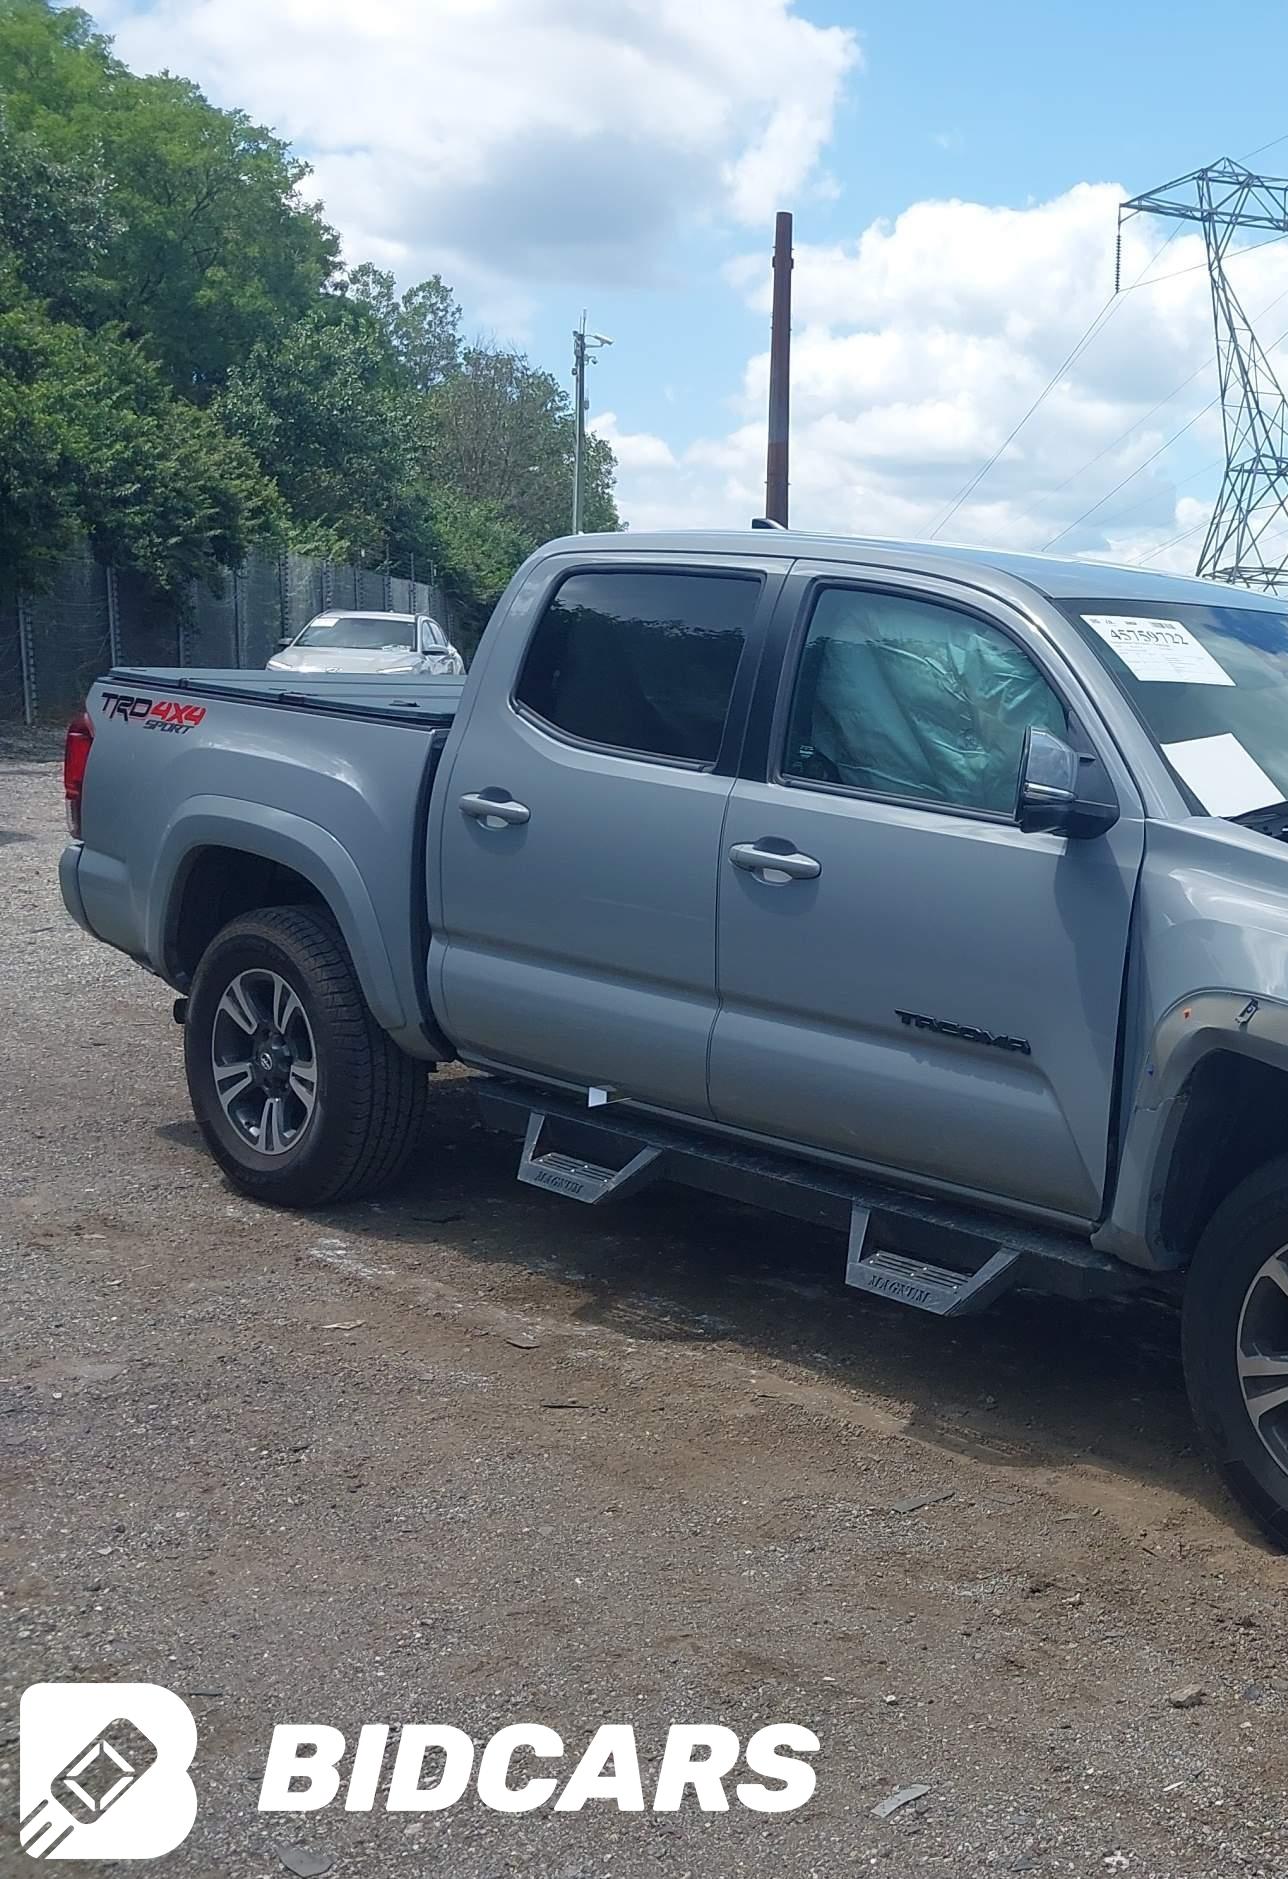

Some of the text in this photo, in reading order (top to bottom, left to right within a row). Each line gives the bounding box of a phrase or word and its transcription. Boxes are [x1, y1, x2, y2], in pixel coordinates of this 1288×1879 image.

[1110, 628, 1189, 645] 45759722
[101, 692, 153, 722] TRD
[143, 719, 195, 735] SPORT
[894, 1007, 1032, 1055] TACOMA
